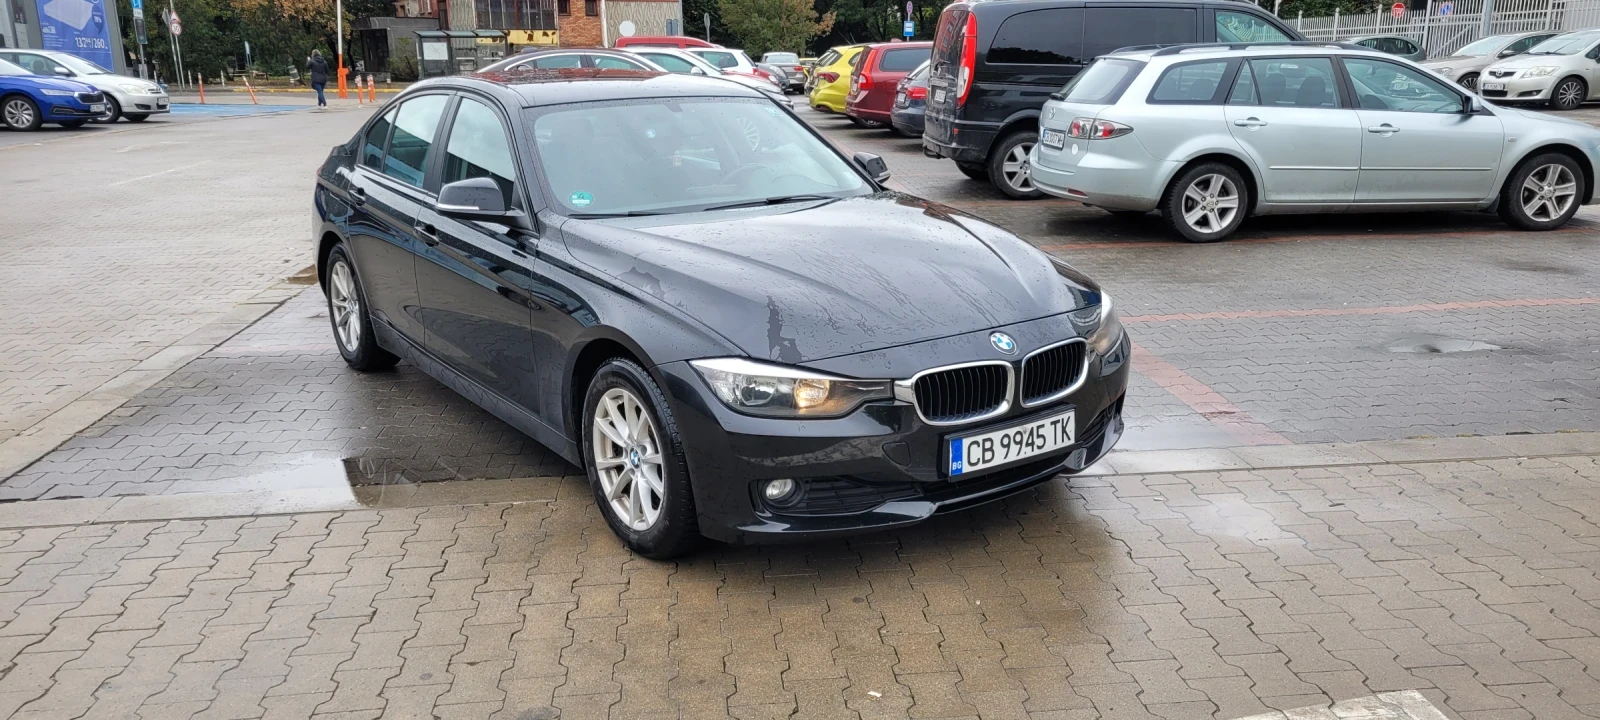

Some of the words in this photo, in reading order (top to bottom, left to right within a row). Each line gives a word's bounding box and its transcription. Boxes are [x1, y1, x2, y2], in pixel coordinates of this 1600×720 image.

[967, 437, 995, 467] CB
[1000, 424, 1046, 460] 9945
[1050, 416, 1071, 445] TK
[952, 461, 962, 470] BG
